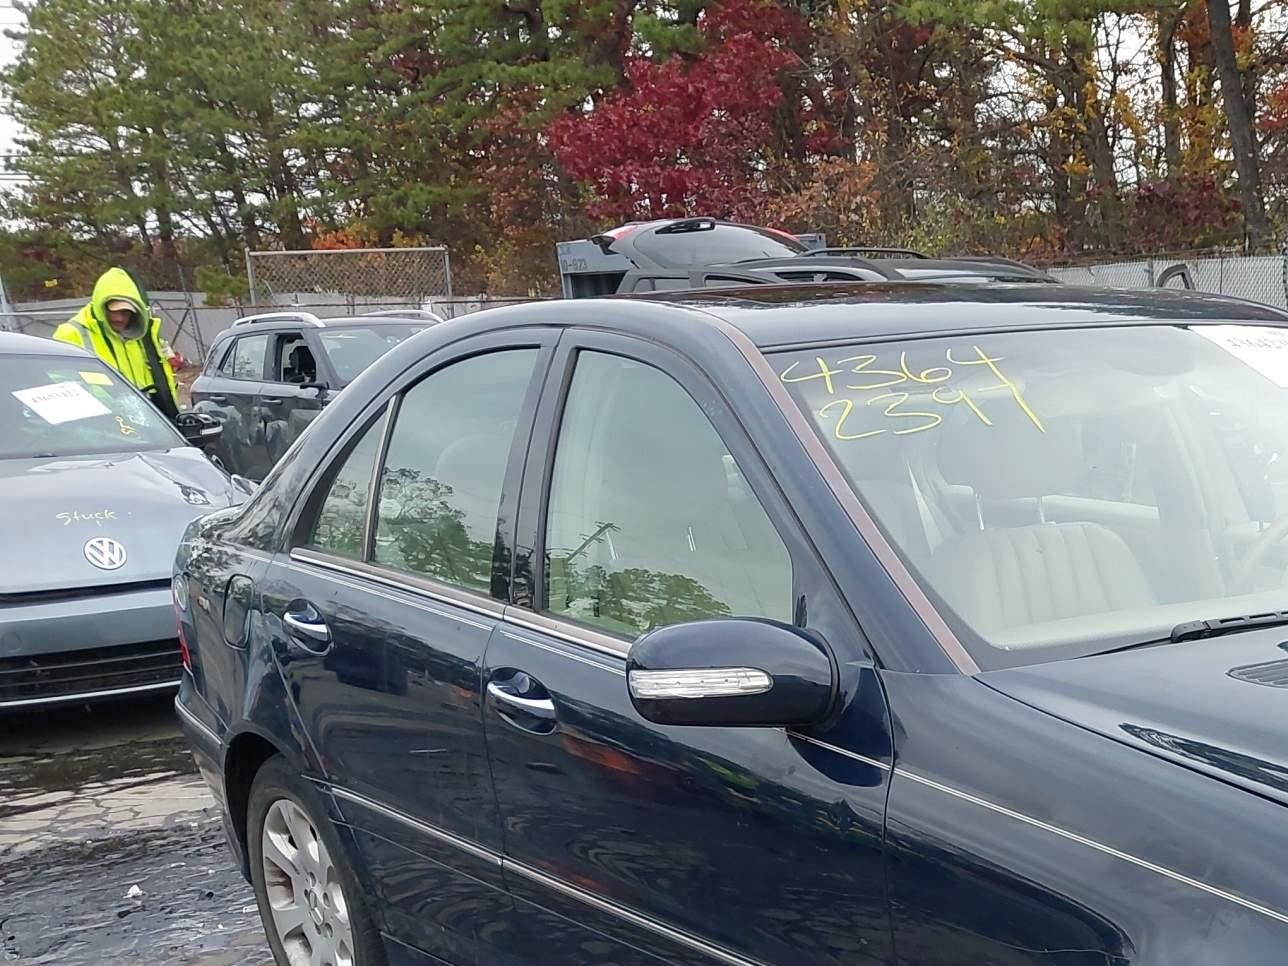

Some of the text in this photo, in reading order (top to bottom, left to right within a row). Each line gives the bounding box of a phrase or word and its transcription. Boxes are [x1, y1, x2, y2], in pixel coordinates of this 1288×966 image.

[780, 345, 1005, 394] 4364
[818, 383, 1046, 440] 2397
[55, 509, 118, 526] Stuck
